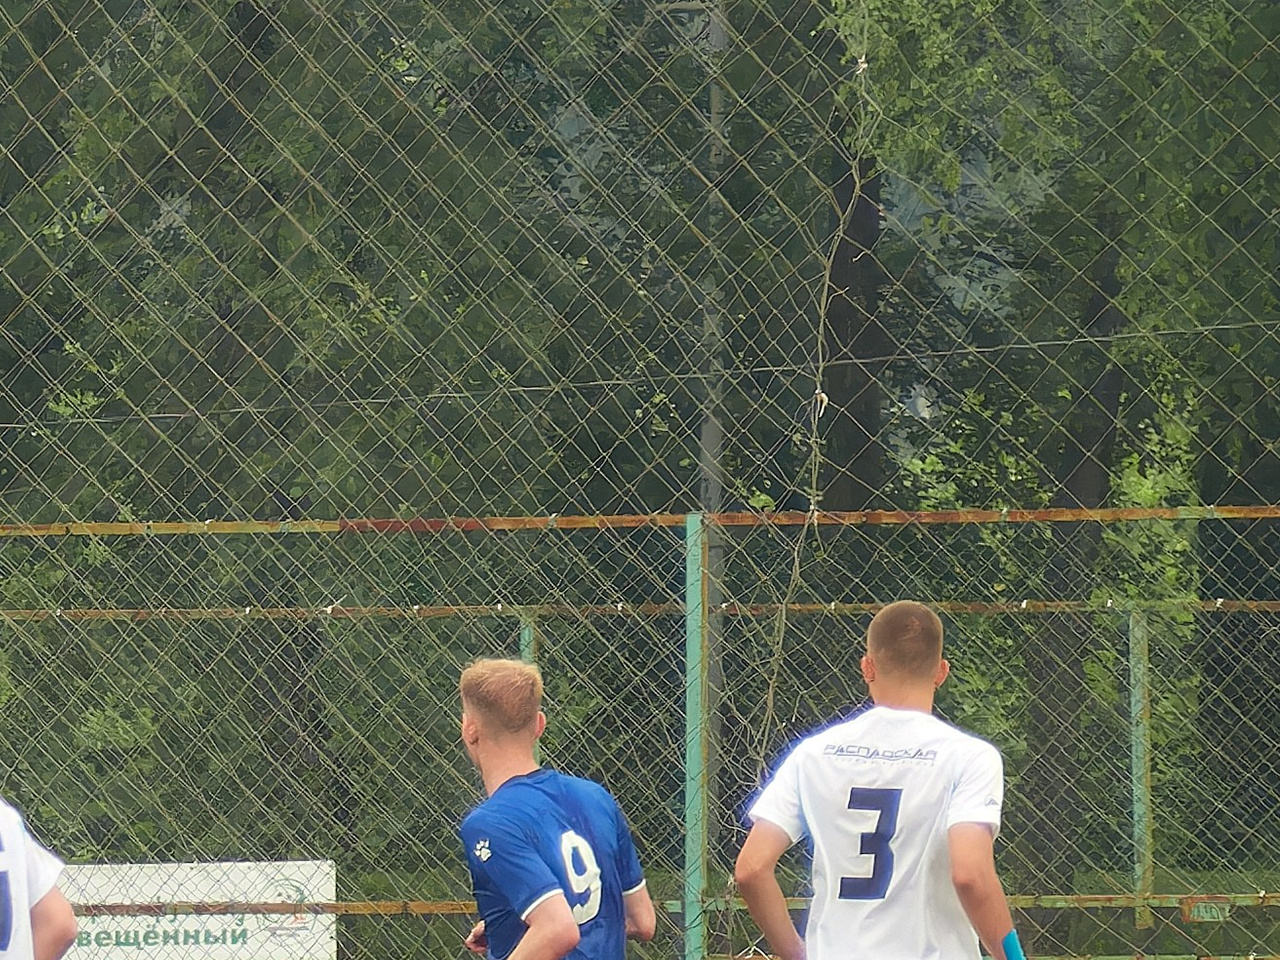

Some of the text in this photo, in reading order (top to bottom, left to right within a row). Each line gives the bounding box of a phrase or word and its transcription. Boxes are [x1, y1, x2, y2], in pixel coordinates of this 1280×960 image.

[560, 831, 602, 925] 9
[838, 787, 904, 900] 3
[76, 924, 249, 950] вещённый
